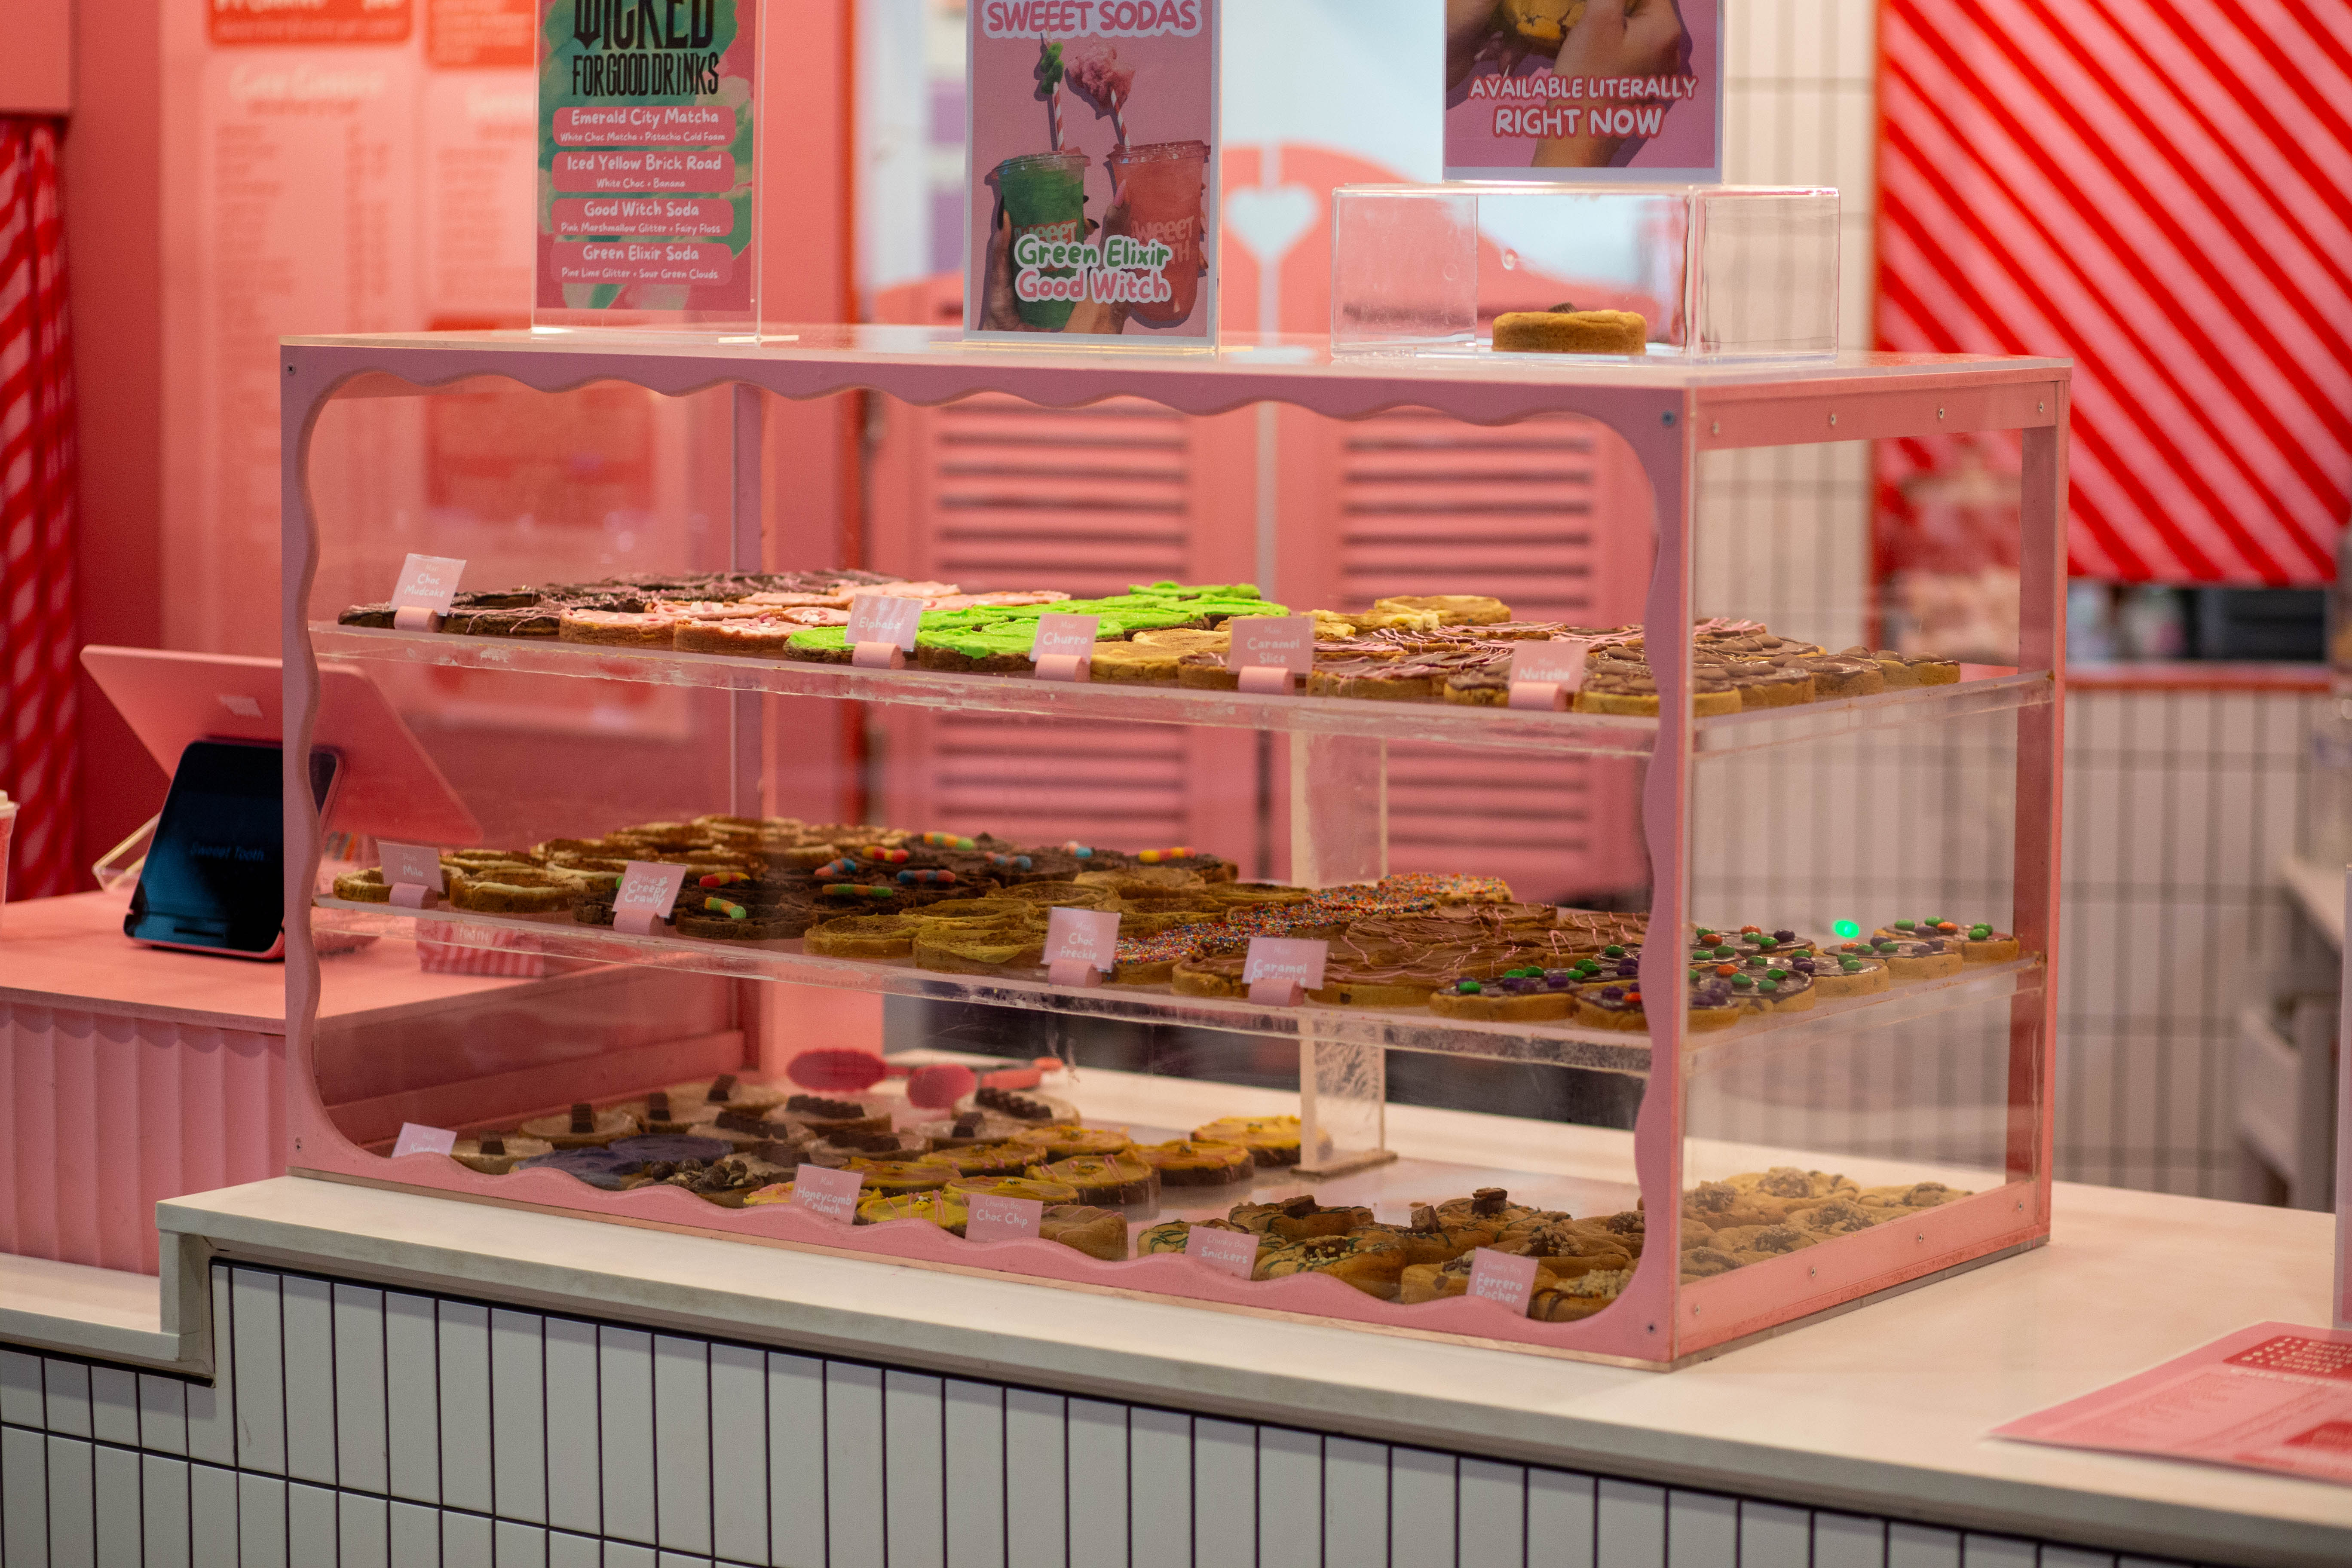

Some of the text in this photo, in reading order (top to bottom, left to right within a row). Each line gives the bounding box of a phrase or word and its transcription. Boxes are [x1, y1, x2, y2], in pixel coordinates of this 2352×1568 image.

[988, 0, 1196, 32] SWEEET SODAS
[572, 52, 720, 96] FOR GOOD DRINKS
[1470, 78, 1696, 98] AVAILABLE LITERALLY
[571, 107, 719, 129] Emerald City Matcha
[1495, 108, 1662, 135] RIGHT NOW
[560, 131, 726, 142] White Choc Matcha Pistachio Cold Foam
[567, 153, 722, 171] Iced Yellow Brick Road
[596, 178, 685, 189] White Choc Banana
[584, 200, 699, 217] Good Witch Soda
[561, 221, 721, 236] Pink Marshmallow Glitter Fairy Floss
[582, 245, 699, 261] Green Elixir Soda
[1017, 238, 1097, 265] Green
[1106, 238, 1169, 267] Elixir
[561, 266, 718, 279] Pine Lime Glitter Sour Green Clouds
[1018, 270, 1168, 299] Good Witch
[417, 573, 441, 585] Choc
[404, 584, 446, 597] Mudcake
[1042, 631, 1088, 646] Churro
[1247, 637, 1300, 650] Caramel
[1259, 652, 1286, 664] Slice
[1519, 666, 1570, 681] Nutella
[628, 880, 668, 897] Creepy
[624, 891, 665, 908] Crawly
[1069, 932, 1094, 946] Choc
[1060, 946, 1097, 960] Freckle
[1253, 959, 1307, 974] Caramel
[797, 1186, 852, 1206] Honeycomb
[976, 1208, 1028, 1228] Choc Chip
[1201, 1246, 1248, 1264] Snickers
[1476, 1272, 1523, 1292] Ferrero
[1476, 1285, 1519, 1304] Rocher
